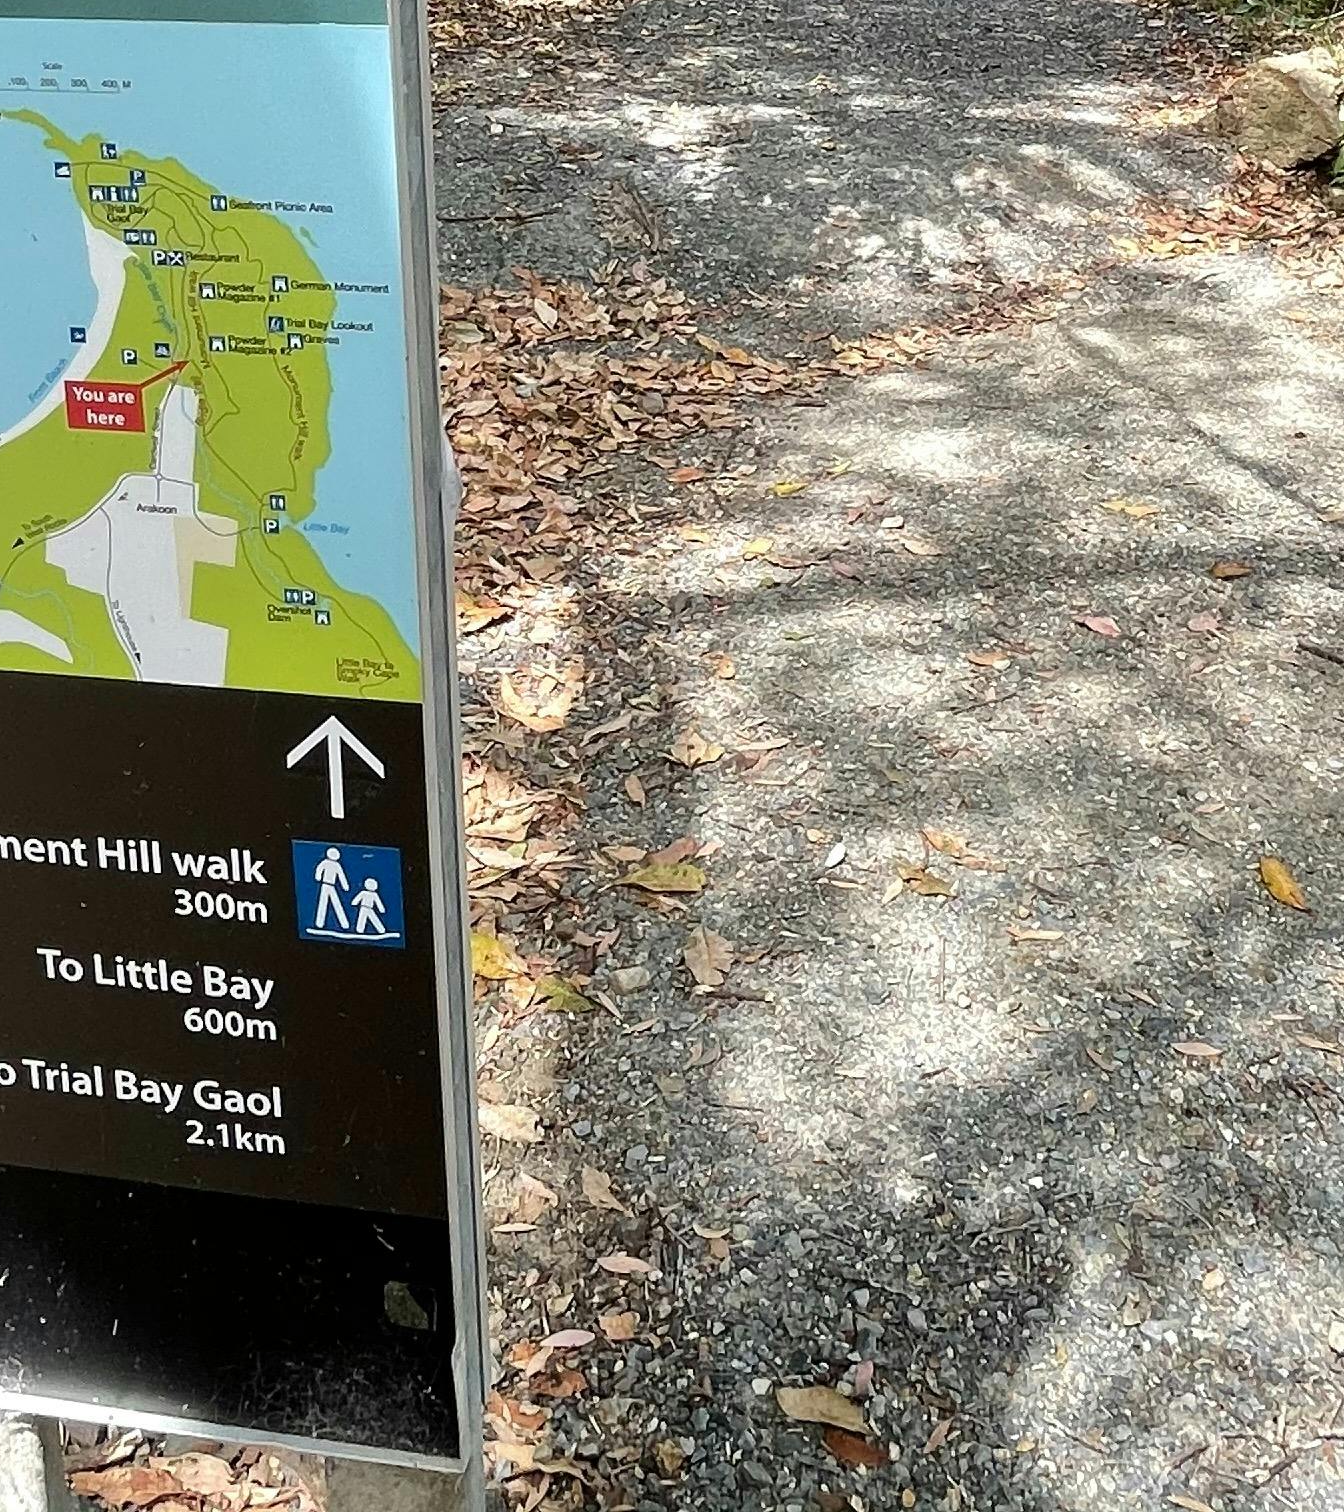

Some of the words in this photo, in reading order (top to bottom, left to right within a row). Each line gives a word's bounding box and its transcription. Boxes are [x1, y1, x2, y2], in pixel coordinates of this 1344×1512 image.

[275, 201, 306, 212] Picnic
[309, 203, 334, 213] Area
[291, 280, 331, 291] German
[335, 282, 389, 294] Monument
[309, 319, 329, 331] Bay
[331, 321, 374, 332] Lookout
[72, 387, 104, 402] You
[107, 392, 136, 404] are
[86, 409, 126, 426] here
[137, 504, 177, 514] Arakoon
[98, 837, 162, 873] Hill
[171, 849, 268, 884] walk
[174, 889, 268, 923] 300m
[36, 948, 84, 982] To
[93, 954, 193, 994] Little
[203, 965, 274, 1010] Bay
[184, 1007, 277, 1040] 600m
[21, 1058, 104, 1097] Trial
[114, 1069, 183, 1113] Bay
[193, 1080, 282, 1118] Gaol
[185, 1120, 286, 1155] 2.1km
